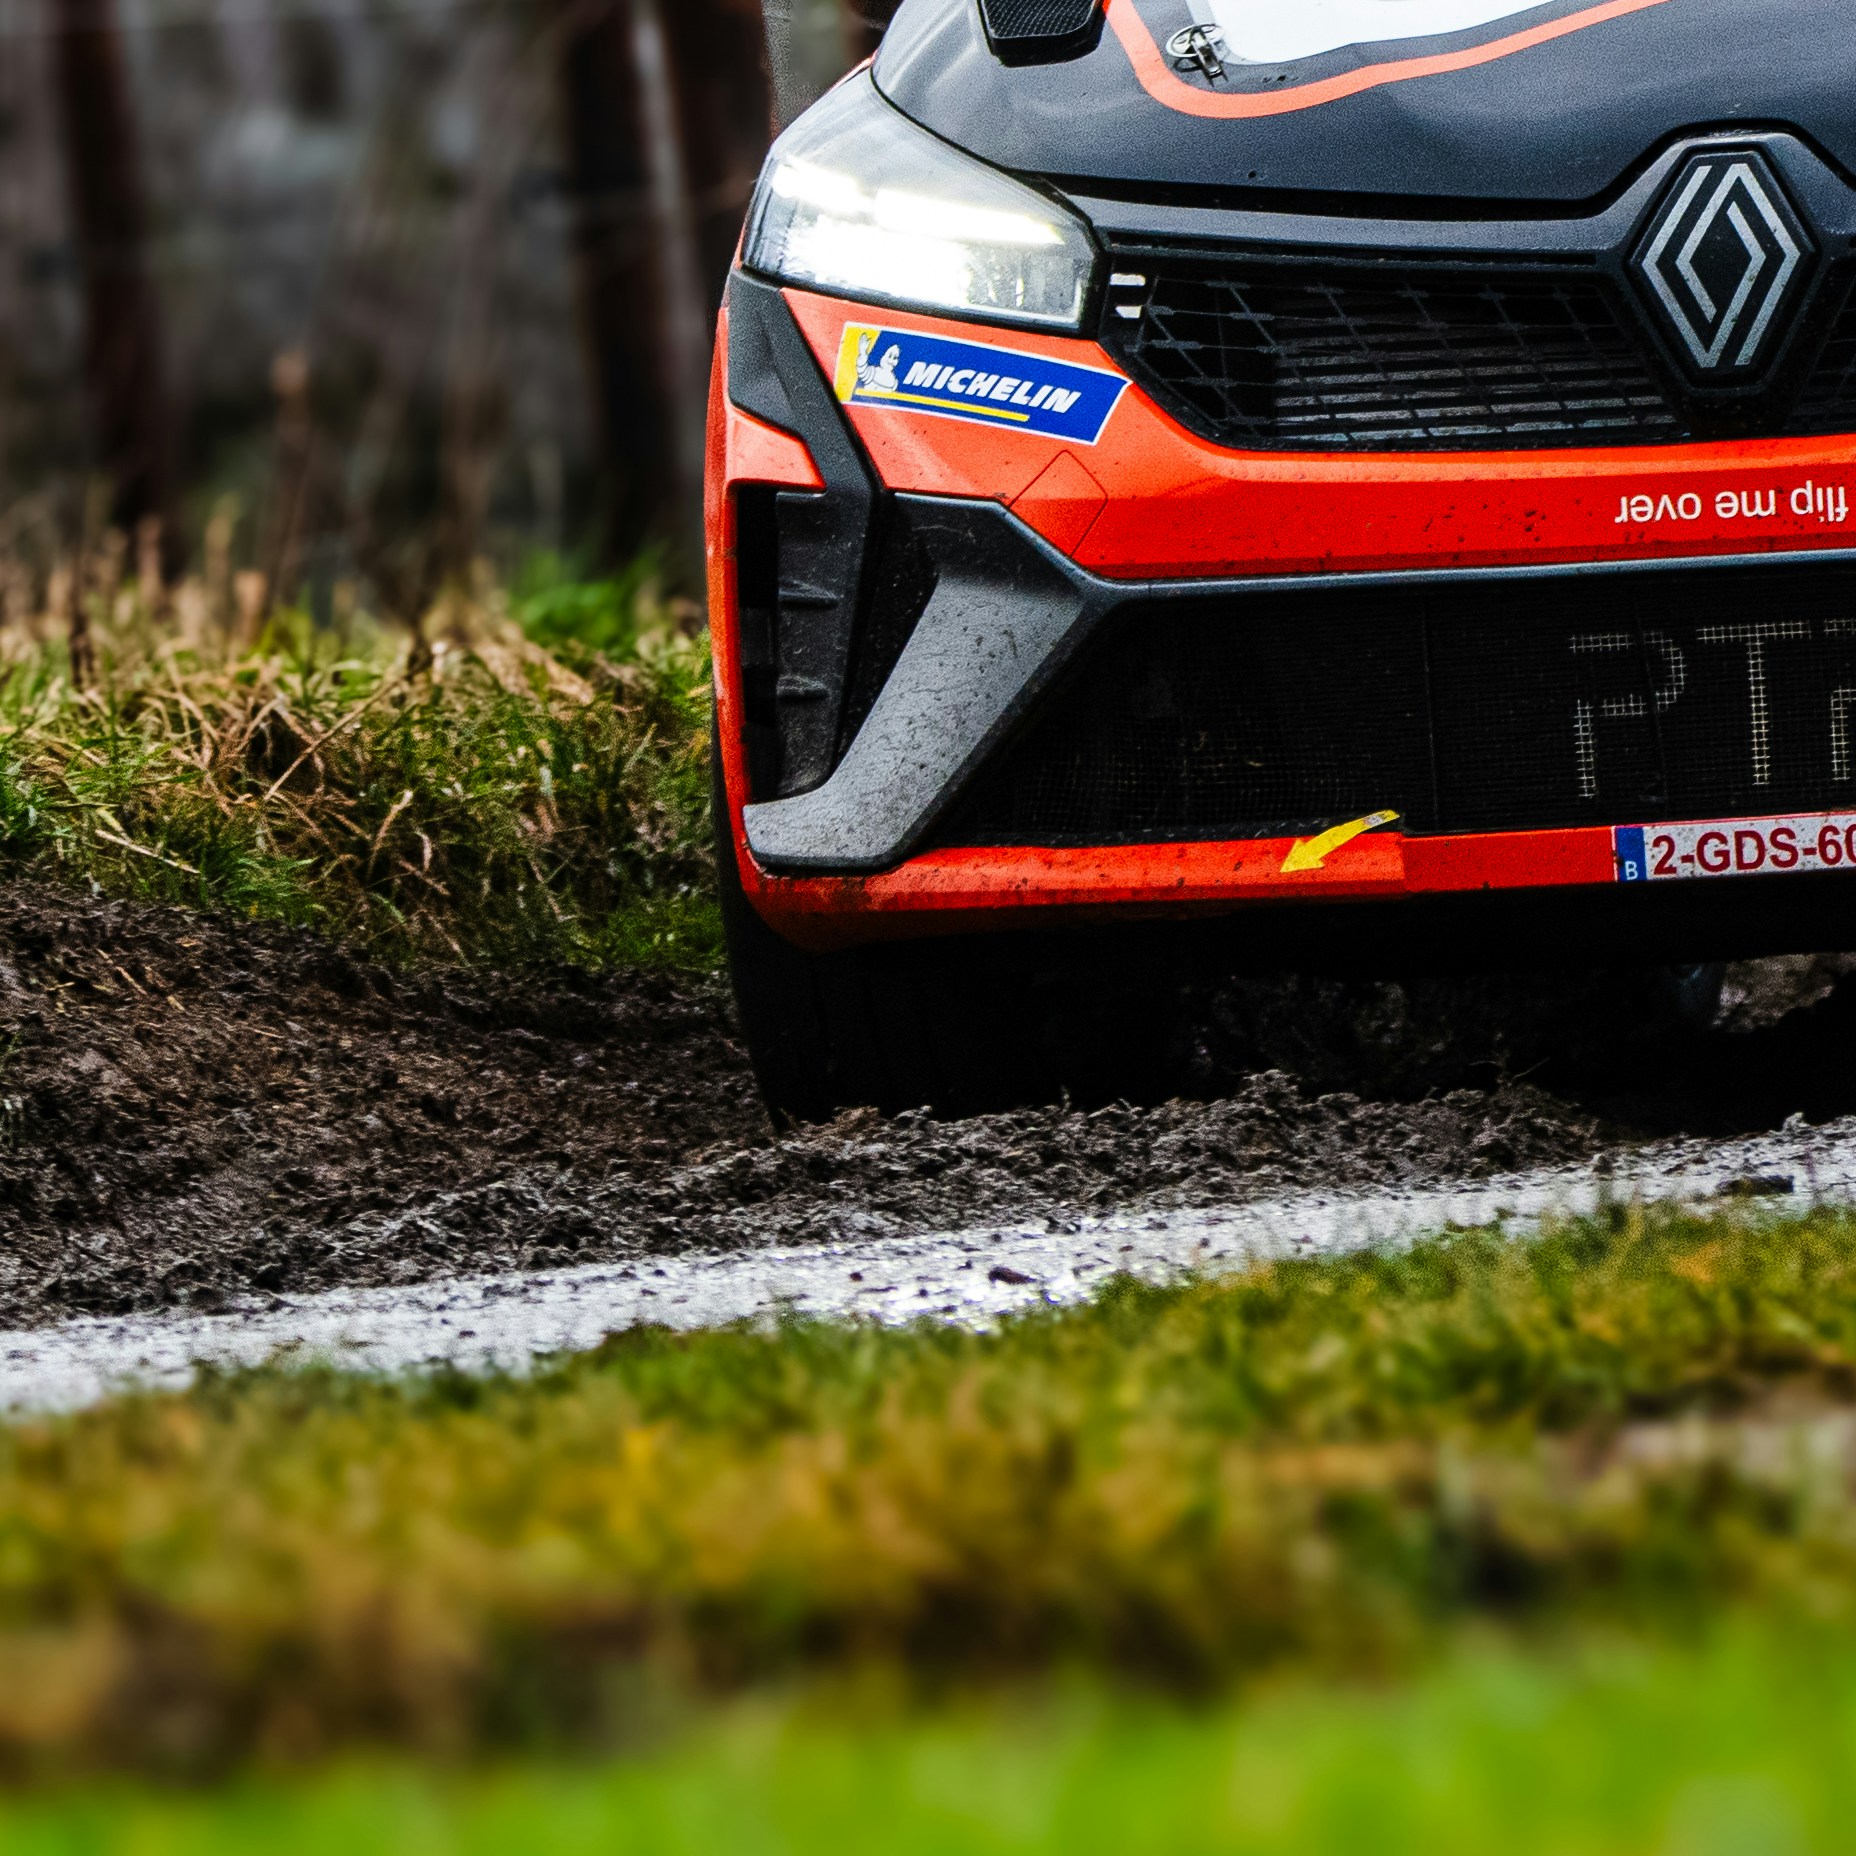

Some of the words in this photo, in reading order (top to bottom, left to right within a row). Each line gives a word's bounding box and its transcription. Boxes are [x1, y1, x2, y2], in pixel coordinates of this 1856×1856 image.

[903, 361, 1082, 414] MICHELIN
[1614, 492, 1701, 524] over
[1715, 489, 1776, 519] me
[1790, 479, 1849, 523] flip
[1624, 860, 1640, 882] B
